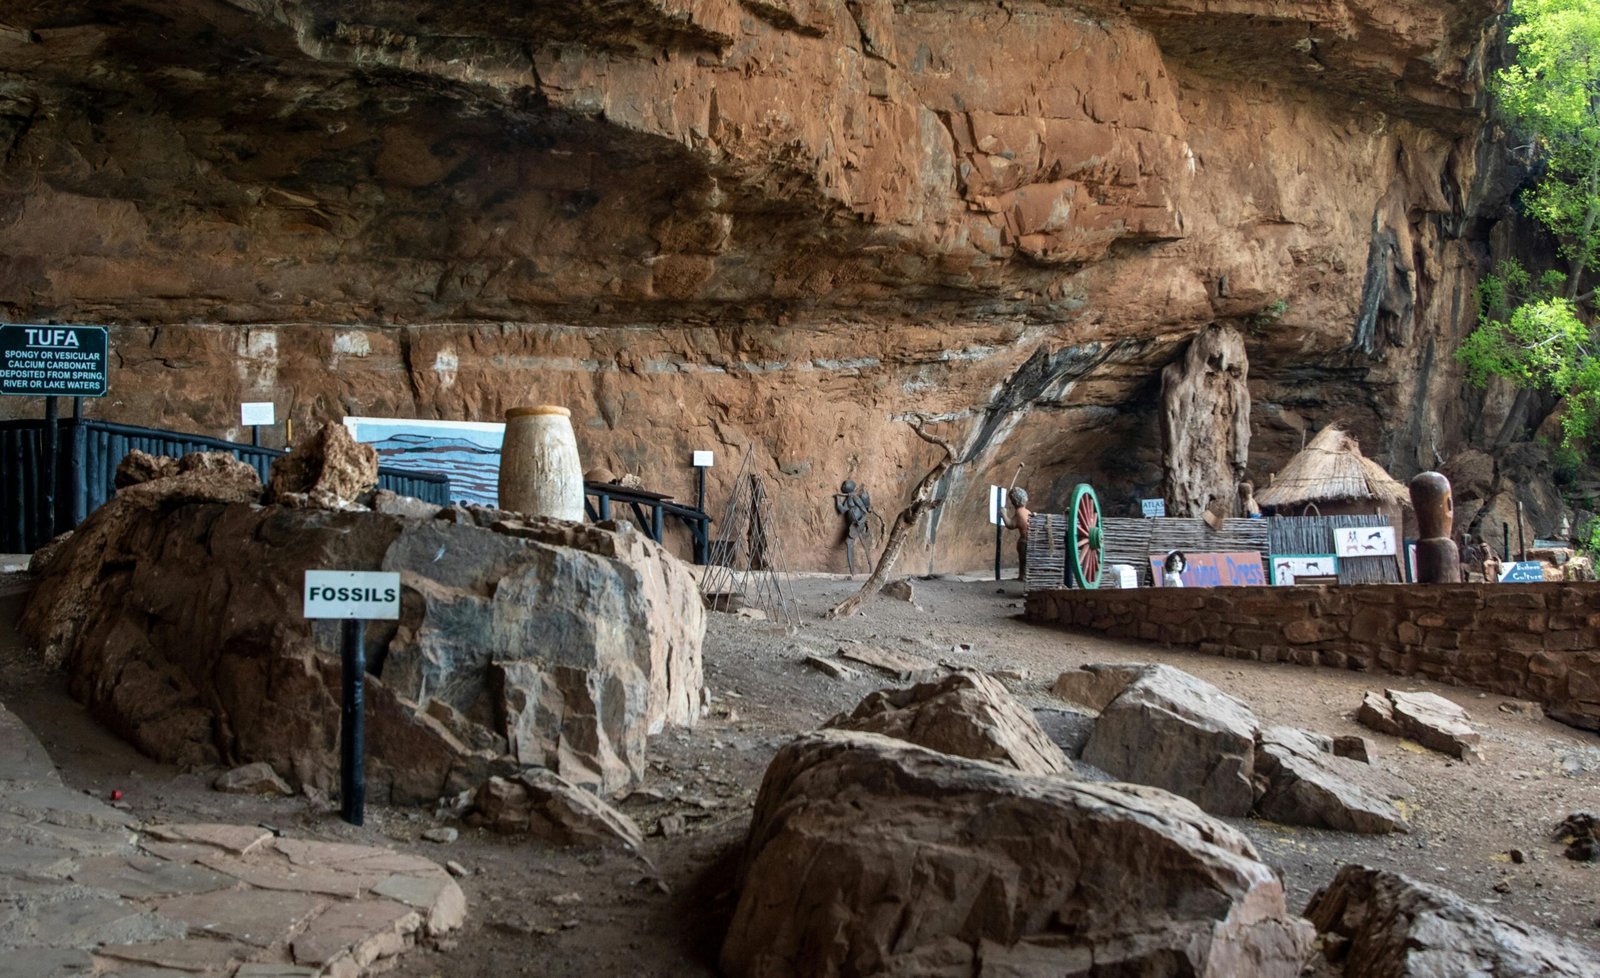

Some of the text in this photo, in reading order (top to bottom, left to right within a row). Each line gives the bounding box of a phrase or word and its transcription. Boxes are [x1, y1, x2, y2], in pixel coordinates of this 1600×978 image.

[25, 329, 80, 345] TUFA
[4, 350, 100, 360] SPONGY OR VESICULAR
[8, 360, 96, 370] CALCIUM CARBONATE
[0, 369, 104, 381] DEPOSITED FROM SPRING,
[3, 380, 28, 388] RIVER
[44, 381, 65, 389] LAKE
[67, 382, 100, 390] WATERS
[1512, 572, 1543, 580] Culture
[309, 587, 396, 602] FOSSILS
